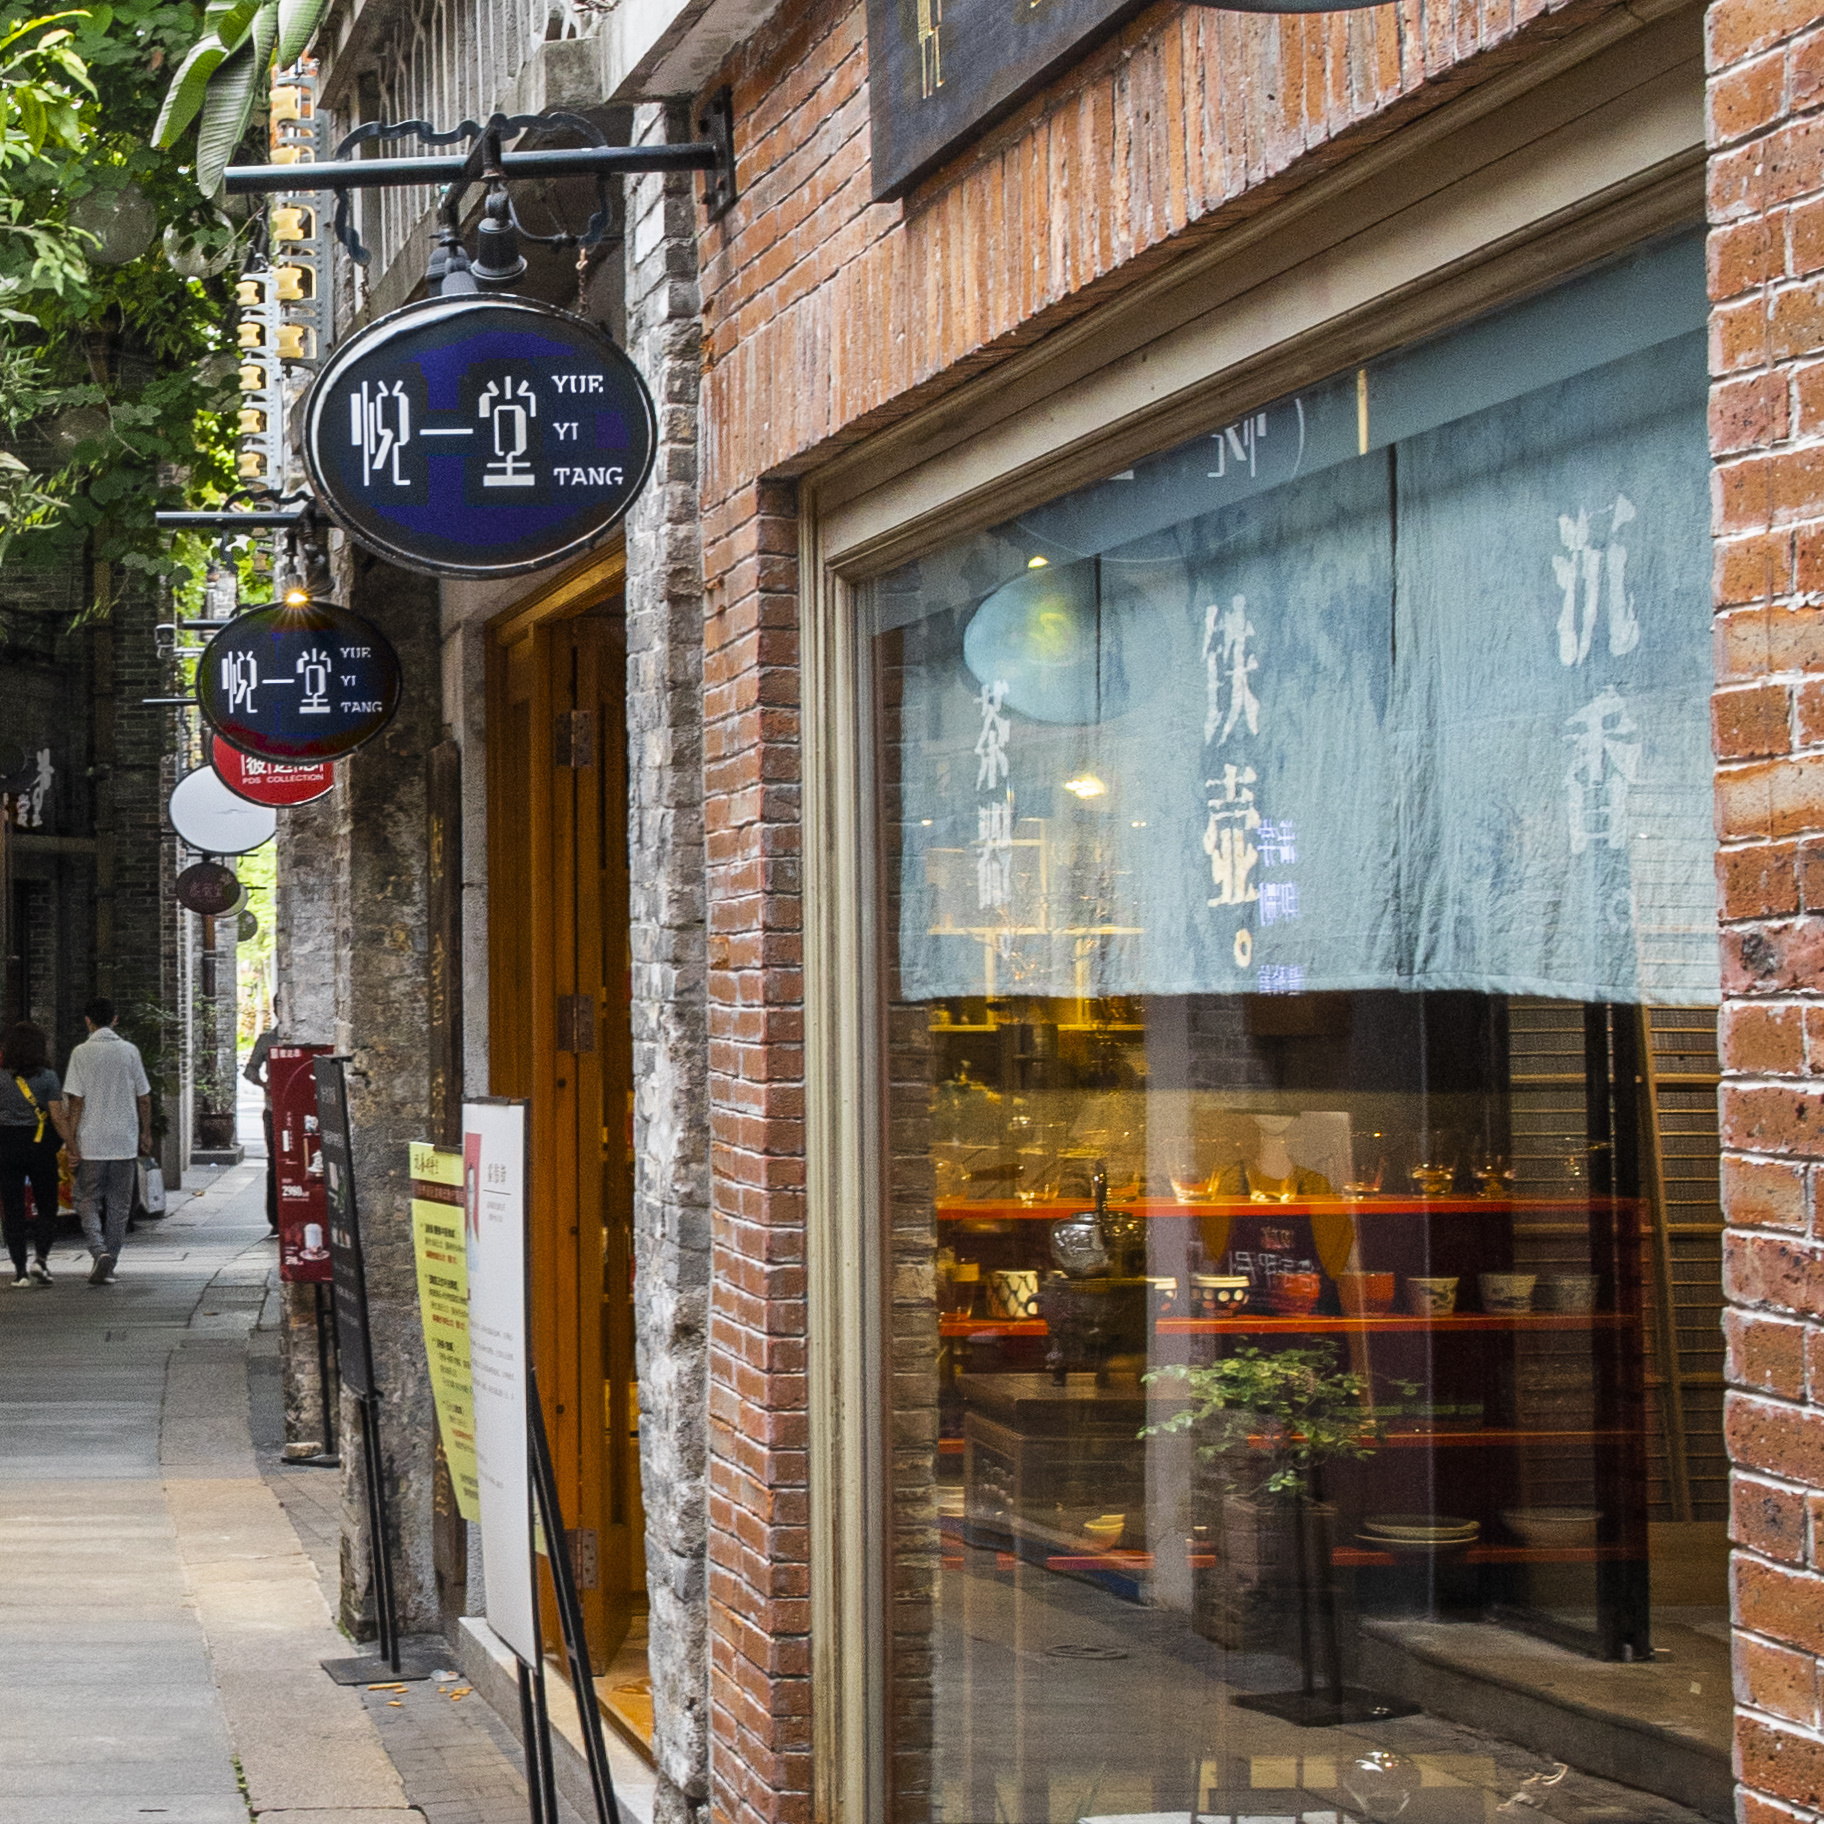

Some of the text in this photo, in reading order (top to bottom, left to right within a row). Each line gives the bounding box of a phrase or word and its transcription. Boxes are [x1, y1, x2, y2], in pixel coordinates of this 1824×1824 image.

[550, 375, 604, 394] YUE
[349, 375, 537, 487] 悦一堂
[552, 423, 579, 441] YI
[553, 468, 624, 486] TANG
[339, 647, 371, 659] YUE
[221, 648, 332, 714] 悦一堂
[340, 675, 356, 686] YI
[340, 701, 382, 713] TANG
[266, 774, 324, 784] COLLECTION
